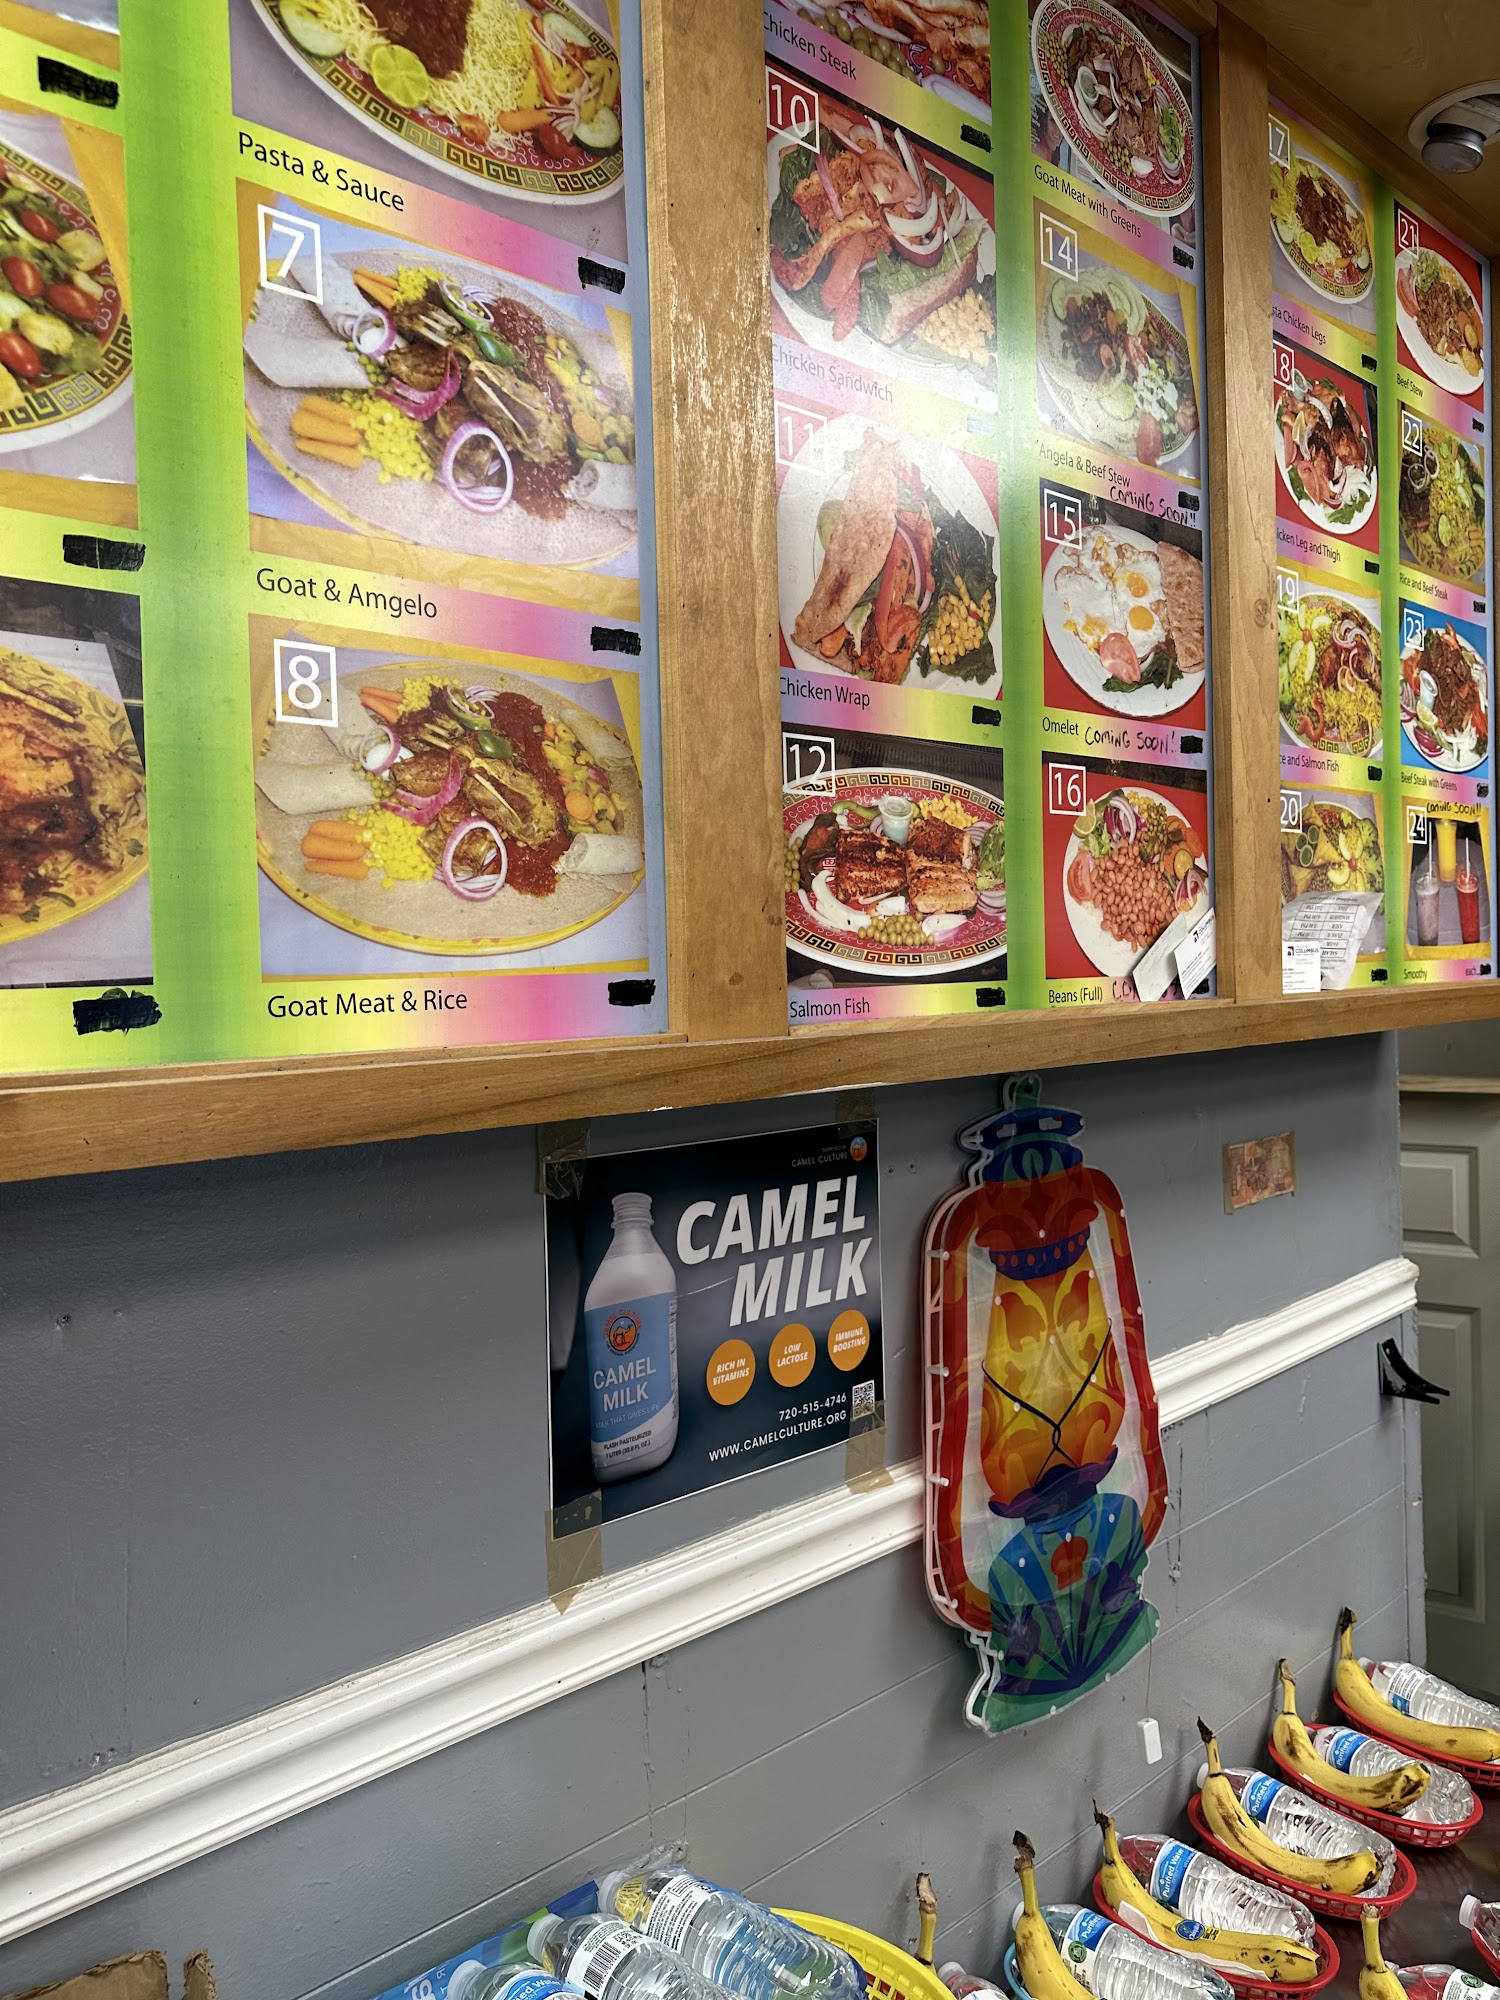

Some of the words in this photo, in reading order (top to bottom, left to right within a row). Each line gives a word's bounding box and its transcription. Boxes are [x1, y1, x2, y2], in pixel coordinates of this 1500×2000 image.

[820, 45, 857, 80] Steak
[771, 83, 810, 138] 10
[239, 131, 304, 176] Pasta
[312, 160, 329, 186] &
[336, 168, 405, 212] Sauce
[1034, 164, 1059, 190] Goat
[1061, 178, 1086, 206] Meat
[1088, 197, 1109, 218] with
[1110, 208, 1141, 238] Greens
[1045, 227, 1073, 270] 14
[1401, 218, 1415, 250] 21
[272, 222, 305, 278] 7
[1283, 310, 1310, 335] Chicken
[1311, 325, 1326, 345] Legs
[772, 343, 825, 380] Chicken
[829, 365, 893, 404] Sandwich
[1273, 348, 1290, 382] 18
[1397, 373, 1409, 389] Beef
[1409, 381, 1423, 398] Stew
[782, 415, 815, 463] 11
[1404, 418, 1419, 450] 22
[1039, 443, 1073, 468] Angela
[1076, 456, 1084, 472] &
[1085, 459, 1106, 479] Beef
[1108, 467, 1131, 487] Stew
[1050, 502, 1076, 541] 15
[1276, 527, 1294, 545] icken
[1296, 534, 1308, 553] Leg
[1309, 542, 1321, 555] and
[1322, 544, 1341, 563] Thigh
[256, 567, 317, 598] Goat
[323, 579, 341, 602] &
[348, 583, 438, 618] Amgelo
[1277, 574, 1295, 605] 19
[1399, 572, 1410, 586] Rice
[1411, 579, 1421, 591] and
[1422, 581, 1434, 595] Beef
[1434, 586, 1448, 600] Steak
[1406, 617, 1422, 642] 23
[288, 654, 322, 710] 8
[780, 677, 832, 702] Chicken
[835, 685, 870, 711] Wrap
[1042, 716, 1079, 736] Omelet
[789, 743, 826, 786] 12
[1287, 754, 1300, 767] and
[1301, 755, 1325, 770] Salmon
[1327, 759, 1340, 773] Fish
[1054, 771, 1081, 807] 16
[1400, 771, 1413, 784] Beef
[1413, 774, 1428, 786] Steak
[1428, 778, 1439, 788] with
[1440, 778, 1458, 791] Greens
[1280, 795, 1298, 826] 20
[1409, 811, 1425, 837] 24
[1403, 968, 1428, 980] Smoothy
[267, 995, 328, 1017] Goat
[336, 993, 395, 1014] Meat
[401, 990, 417, 1012] &
[424, 989, 468, 1010] Rice
[790, 1000, 841, 1018] Salmon
[845, 997, 870, 1014] Fish
[1048, 989, 1077, 1004] Beans
[1080, 987, 1103, 1003] (Full)
[791, 1156, 815, 1167] CAMEL
[817, 1151, 848, 1163] CULTURE
[676, 1175, 866, 1265] CAMEL
[729, 1237, 873, 1327] MILK
[784, 1342, 802, 1355] LOW
[833, 1336, 866, 1353] BOOSTING
[835, 1327, 864, 1341] IMMUNE
[593, 1356, 657, 1390] CAMEL
[716, 1360, 736, 1374] RICH
[736, 1358, 746, 1369] IN
[777, 1352, 808, 1368] LACTOSE
[712, 1367, 750, 1386] VITAMINS
[603, 1381, 649, 1413] MILK
[778, 1392, 847, 1422] 720-515-4746
[610, 1414, 627, 1424] THAT
[627, 1408, 646, 1420] GIVES
[604, 1441, 619, 1450] FLASH
[619, 1430, 652, 1446] PASTEURIZED
[708, 1409, 847, 1462] WWW.CAMELCULTURE.ORG
[608, 1449, 622, 1458] LITER
[1336, 1741, 1350, 1766] Purified
[1251, 1785, 1267, 1813] Purified
[1162, 1866, 1175, 1898] Purified
[1170, 1848, 1185, 1865] Water
